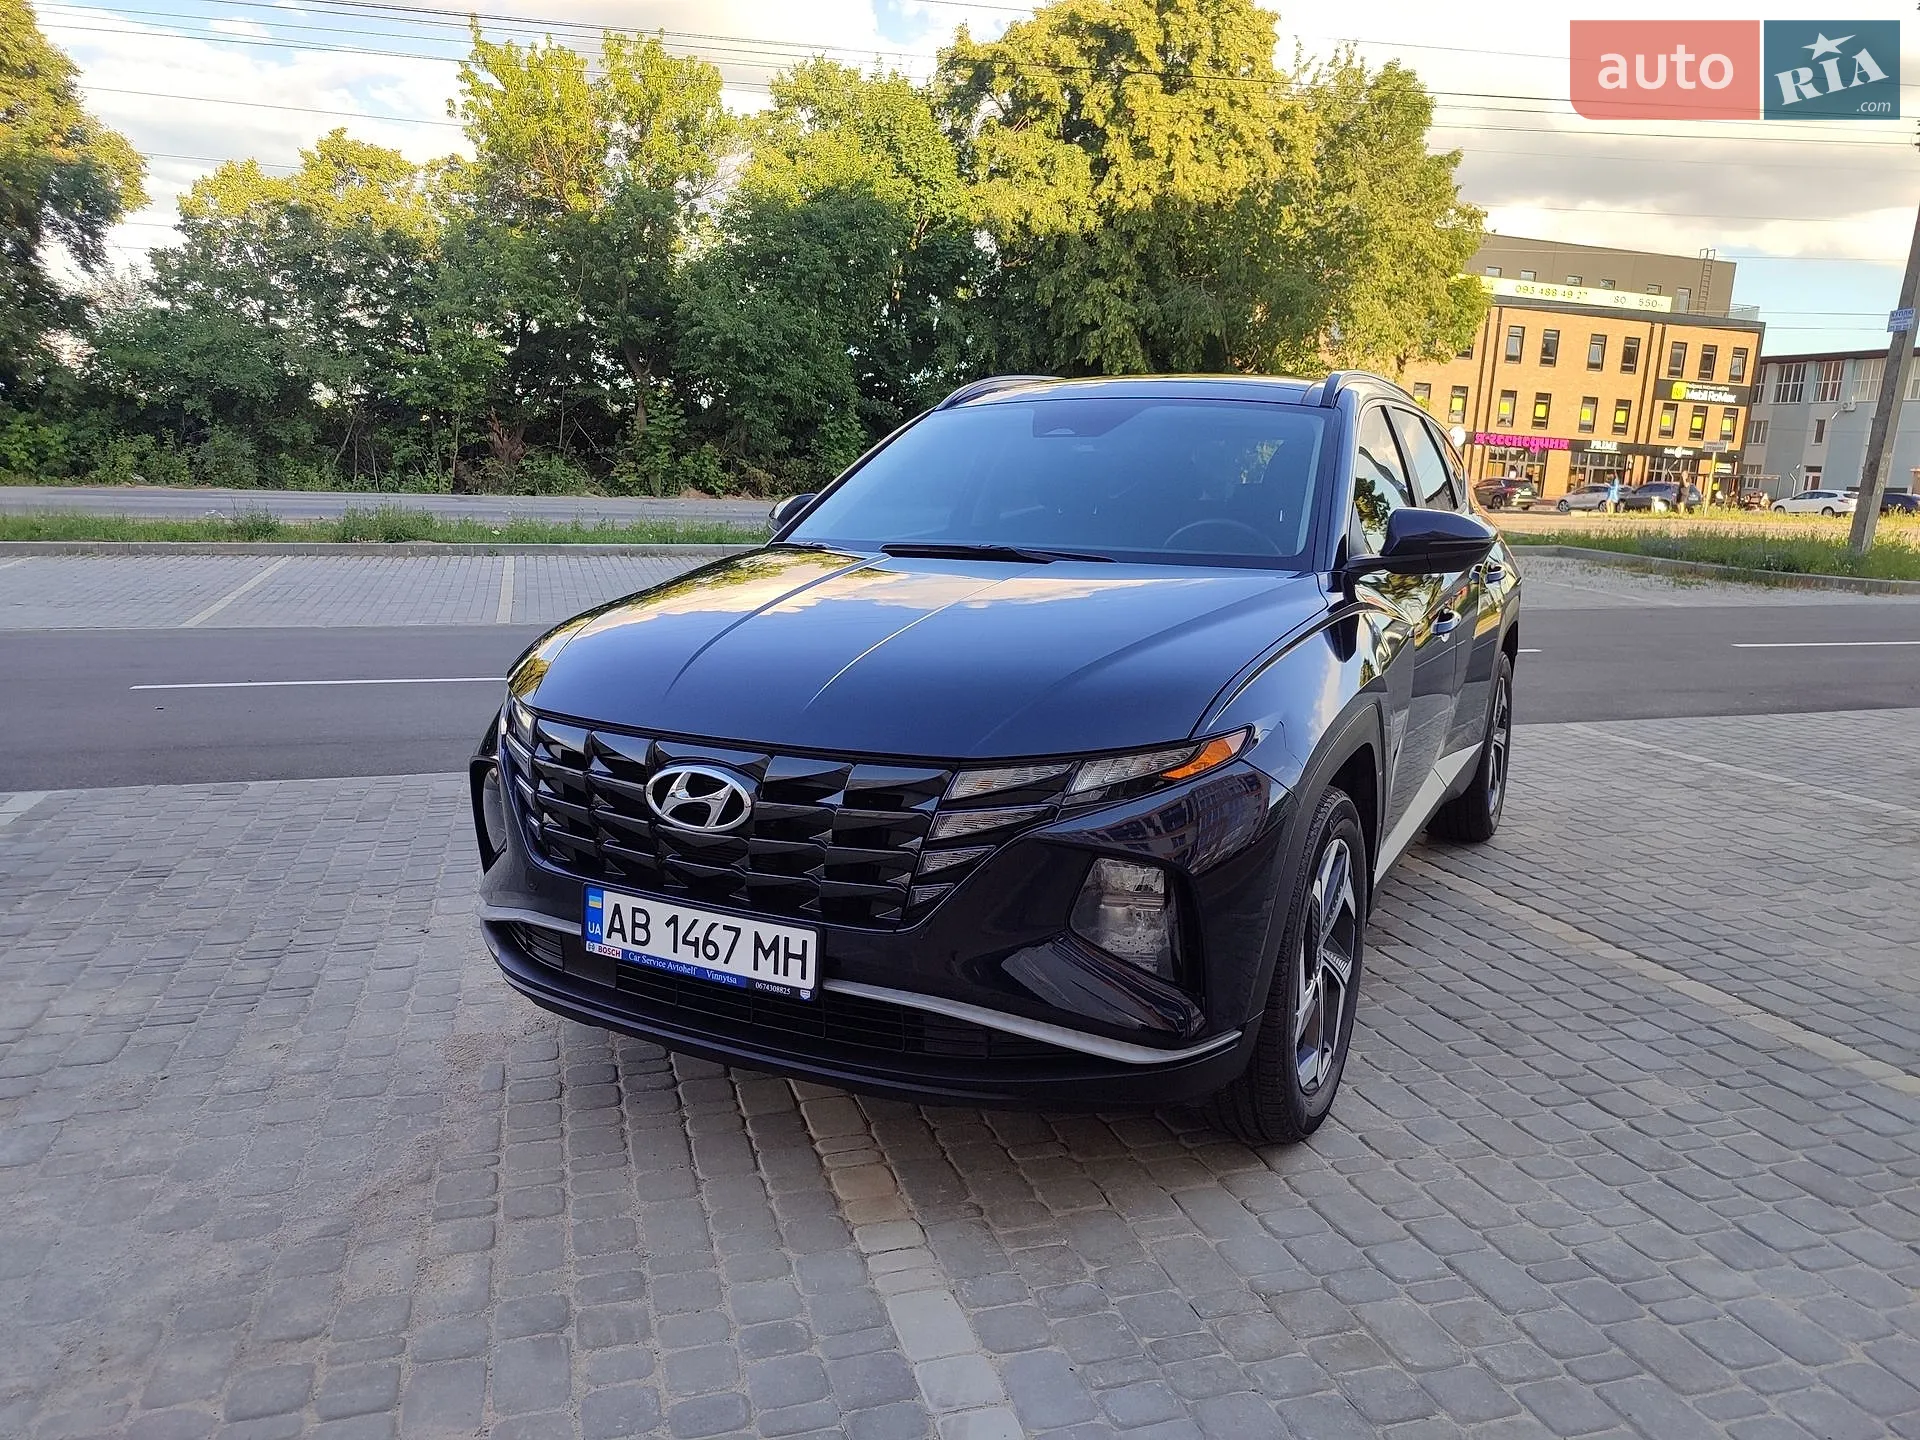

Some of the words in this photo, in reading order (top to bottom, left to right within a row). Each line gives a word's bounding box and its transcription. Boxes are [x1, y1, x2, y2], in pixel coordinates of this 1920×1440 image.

[588, 920, 602, 936] UA
[597, 945, 621, 958] BOSCH
[605, 902, 651, 947] AB
[665, 914, 742, 965] 1467
[752, 930, 808, 981] MH
[628, 952, 641, 962] Car
[641, 955, 667, 969] Service
[706, 969, 738, 985] Vinnytsa
